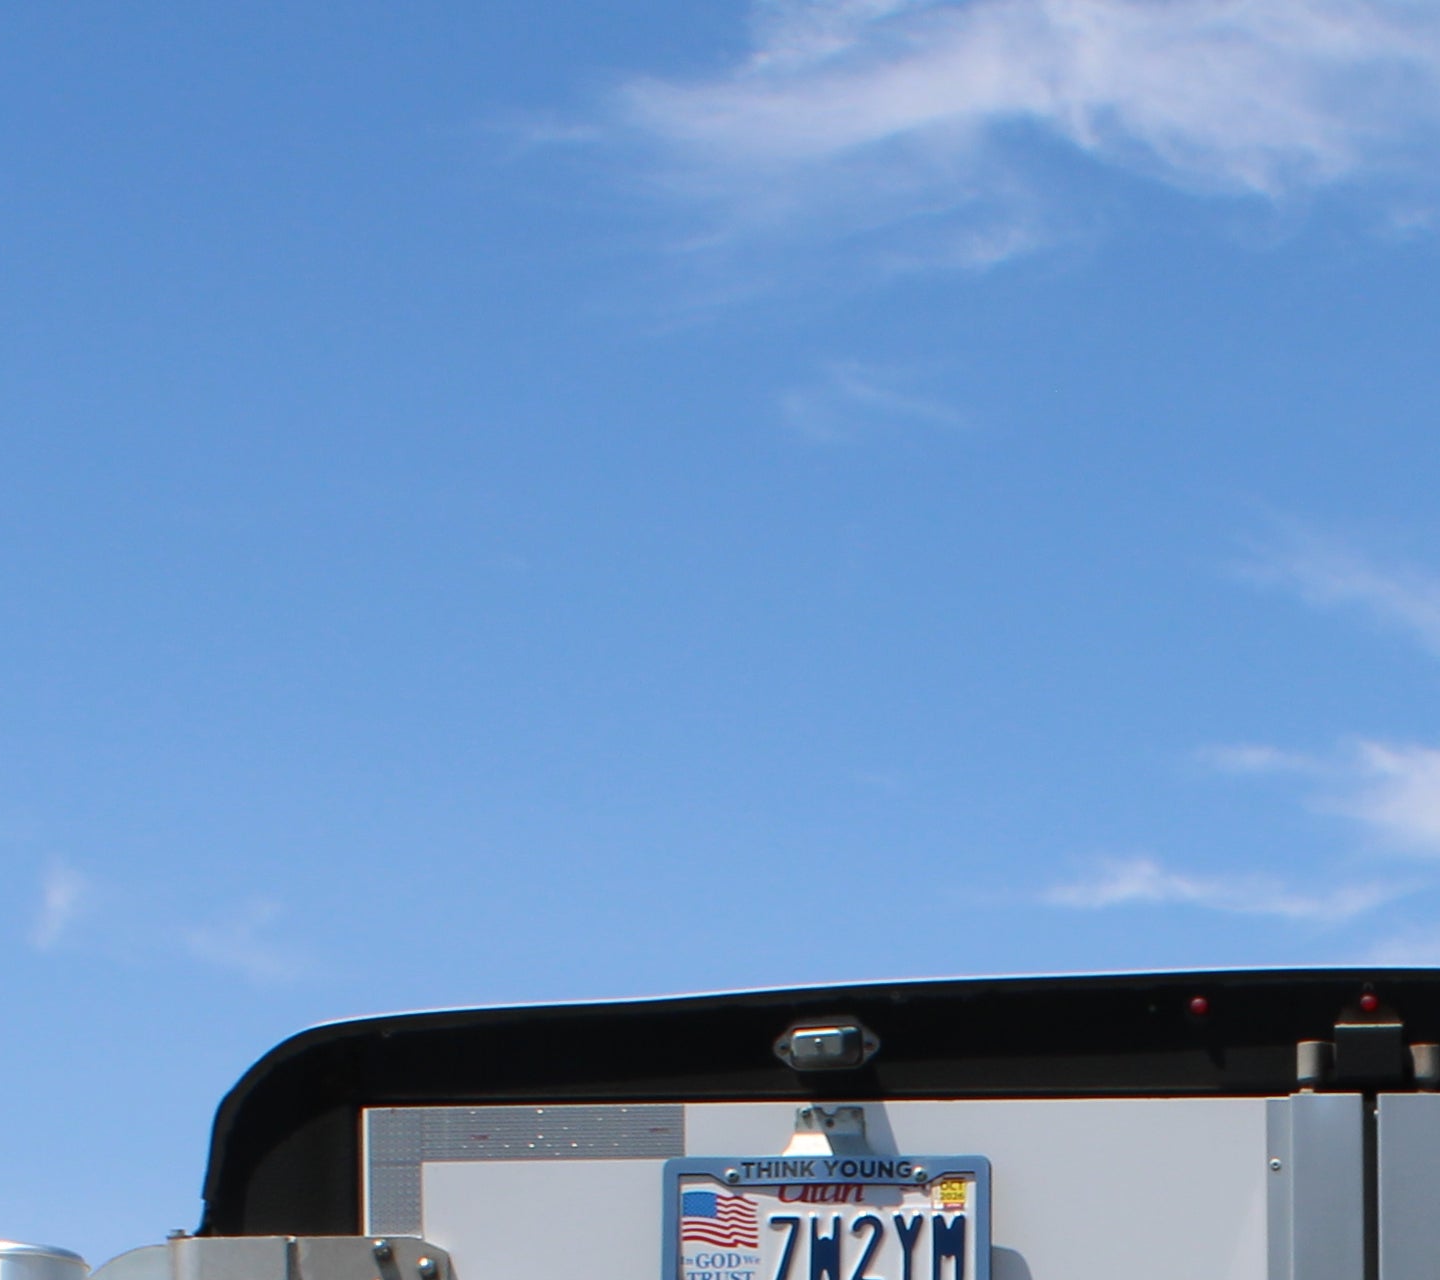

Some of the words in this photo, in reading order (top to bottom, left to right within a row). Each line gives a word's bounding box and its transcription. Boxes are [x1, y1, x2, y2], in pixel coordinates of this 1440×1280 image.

[741, 1160, 815, 1179] THINK
[822, 1159, 913, 1179] YOUNG
[695, 1253, 741, 1269] GOD
[743, 1255, 761, 1265] We
